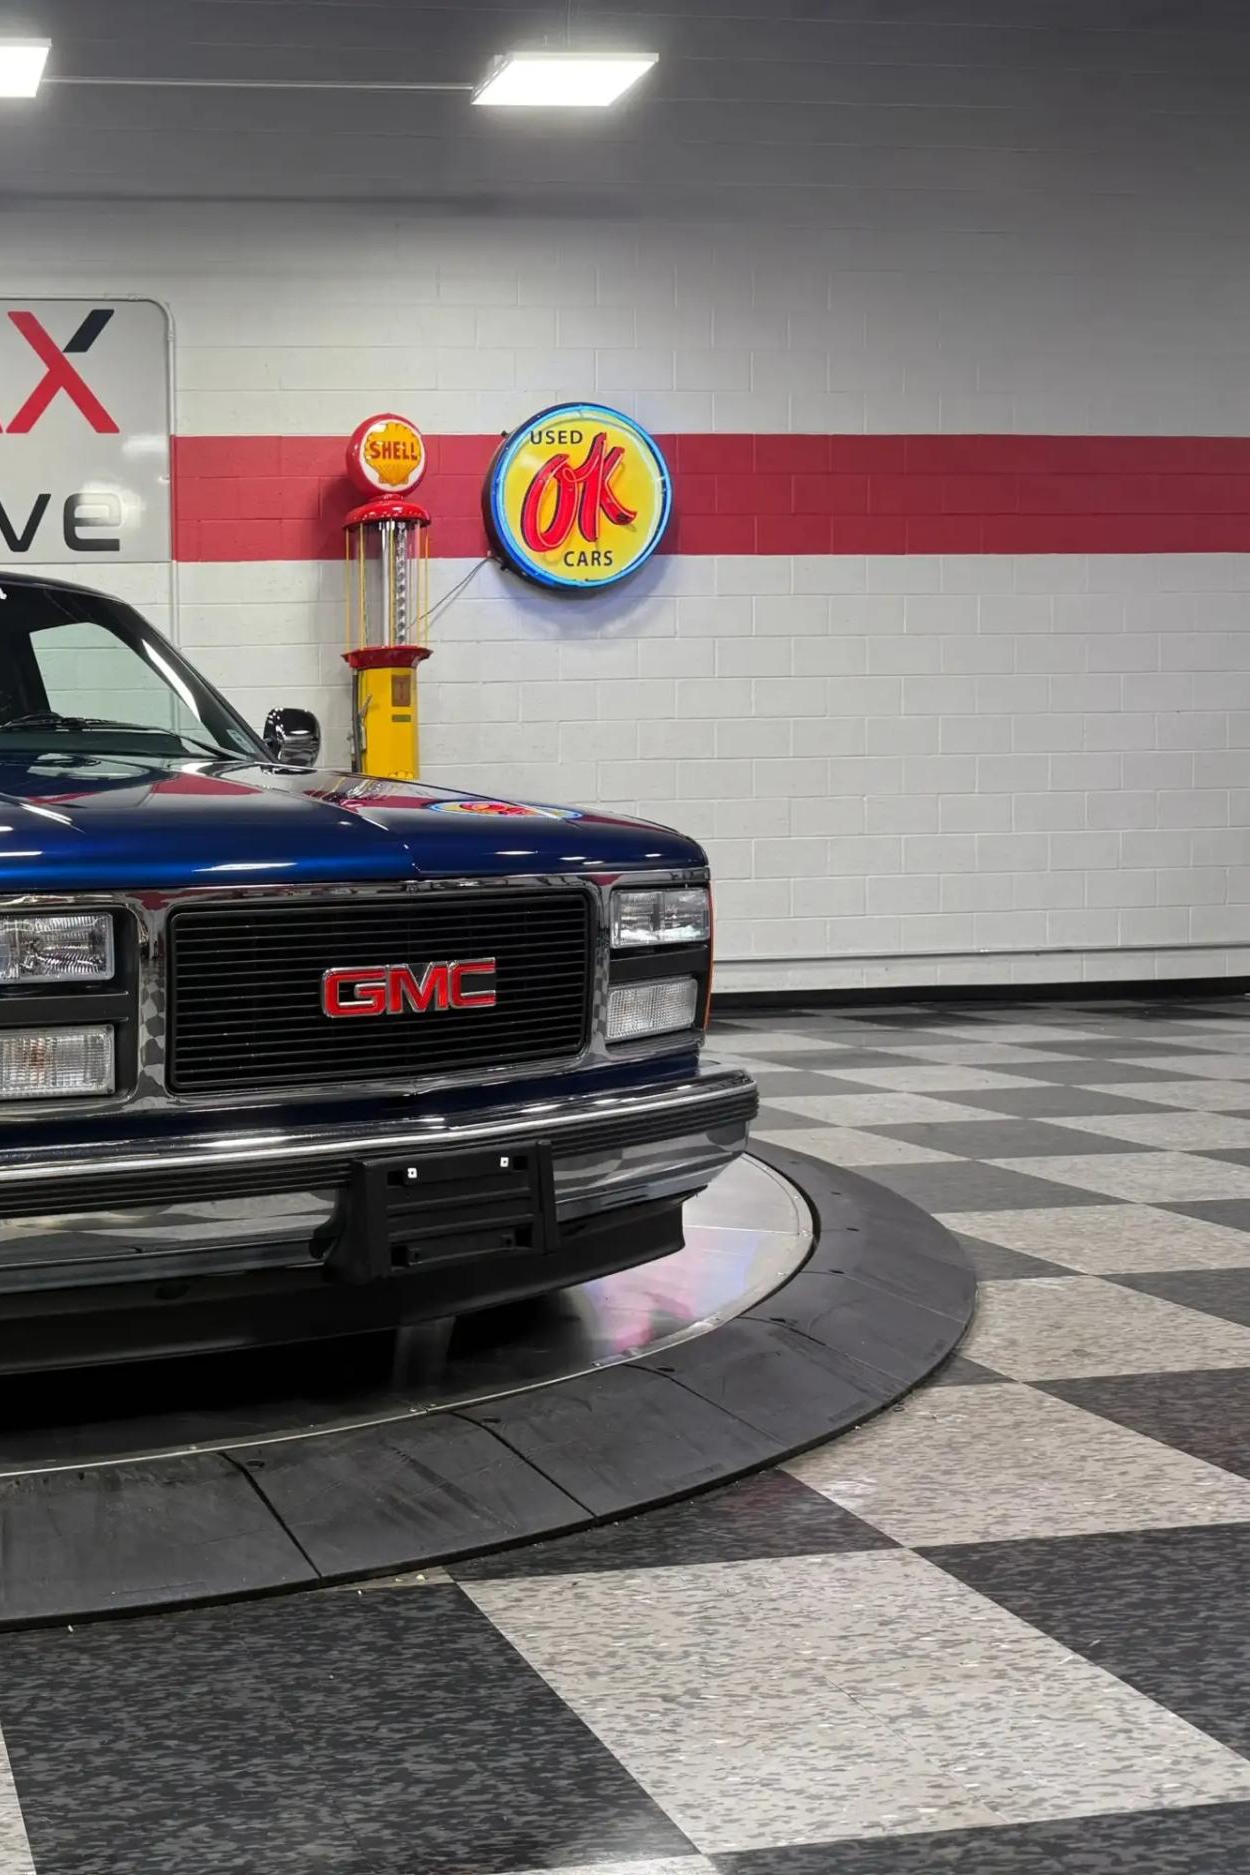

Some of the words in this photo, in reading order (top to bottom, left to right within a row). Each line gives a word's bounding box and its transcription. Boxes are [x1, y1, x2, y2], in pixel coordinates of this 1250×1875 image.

[530, 429, 584, 446] USED
[368, 441, 419, 462] SHELL
[520, 432, 638, 553] OK
[563, 550, 614, 568] CARS
[322, 957, 496, 1018] GMC
